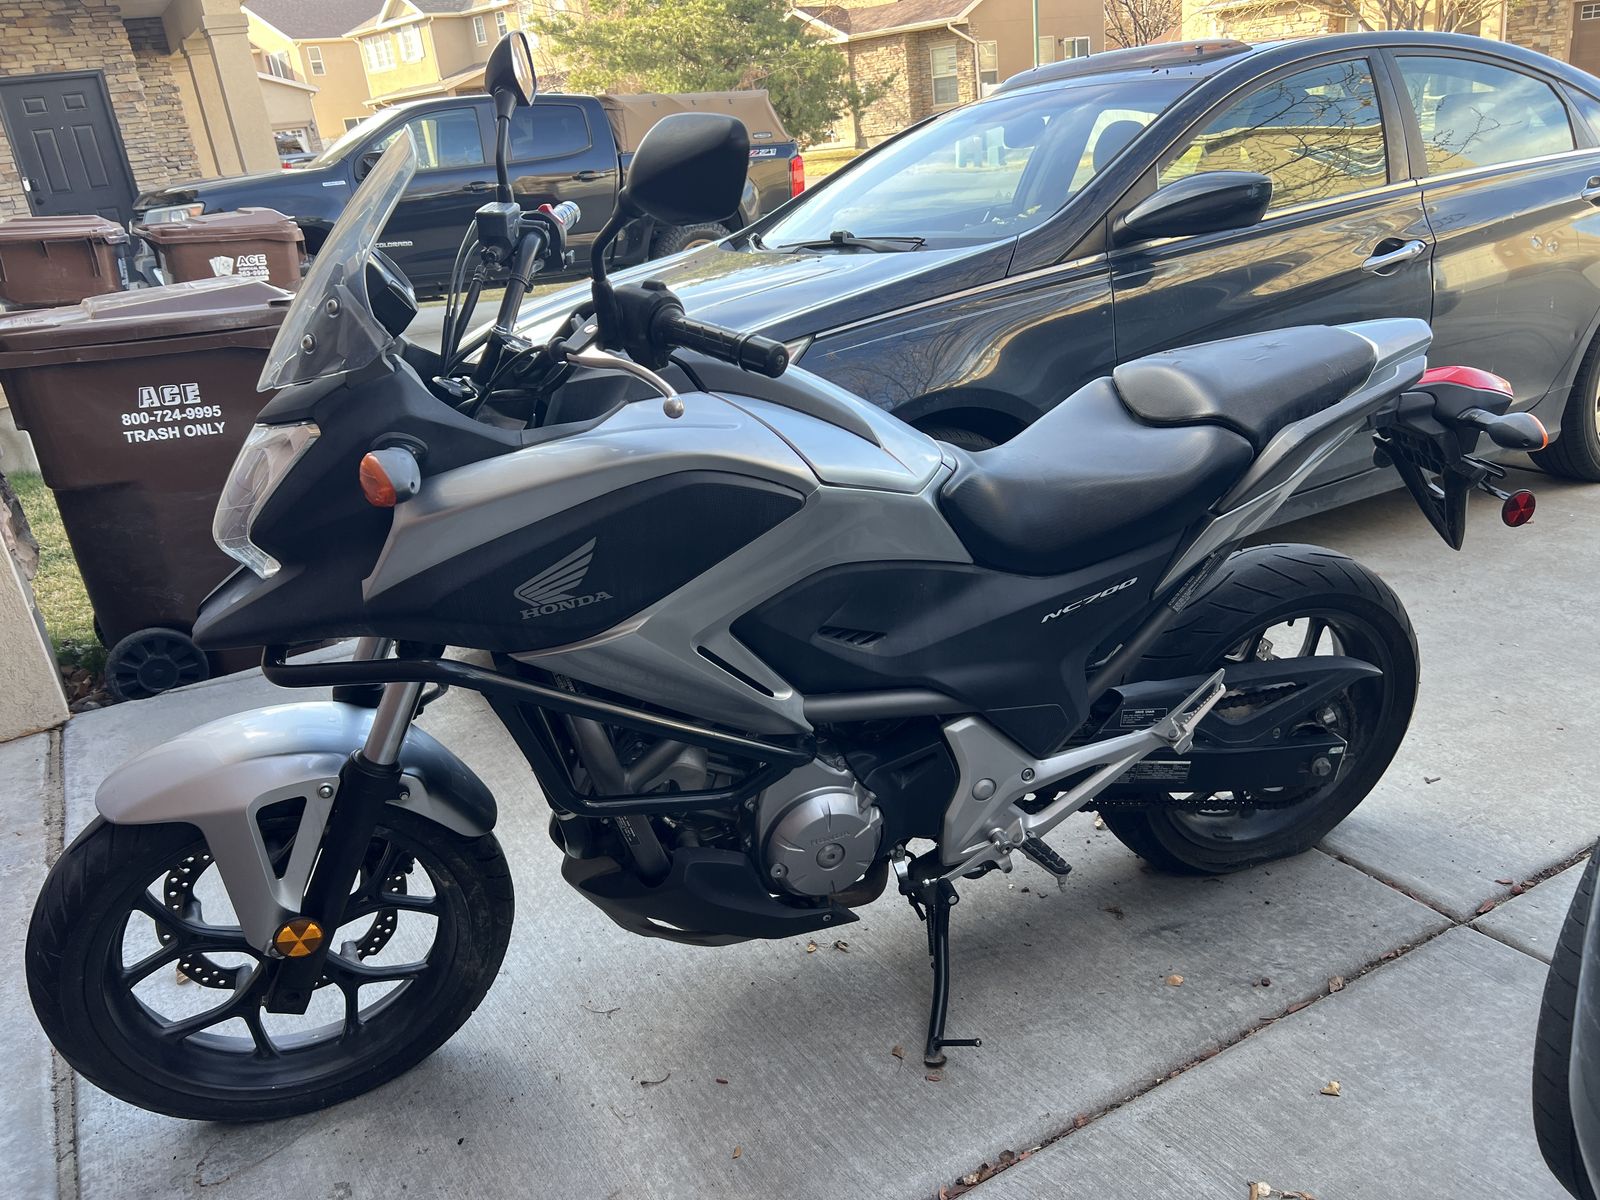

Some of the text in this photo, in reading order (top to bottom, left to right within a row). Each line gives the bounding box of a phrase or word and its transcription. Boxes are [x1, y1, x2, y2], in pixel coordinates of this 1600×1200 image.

[237, 254, 267, 267] ACE
[139, 383, 201, 408] ACE
[121, 405, 222, 426] 800-724-9995
[123, 421, 226, 443] TRASH ONLY
[520, 591, 614, 620] HONDA
[1041, 577, 1138, 624] NC700
